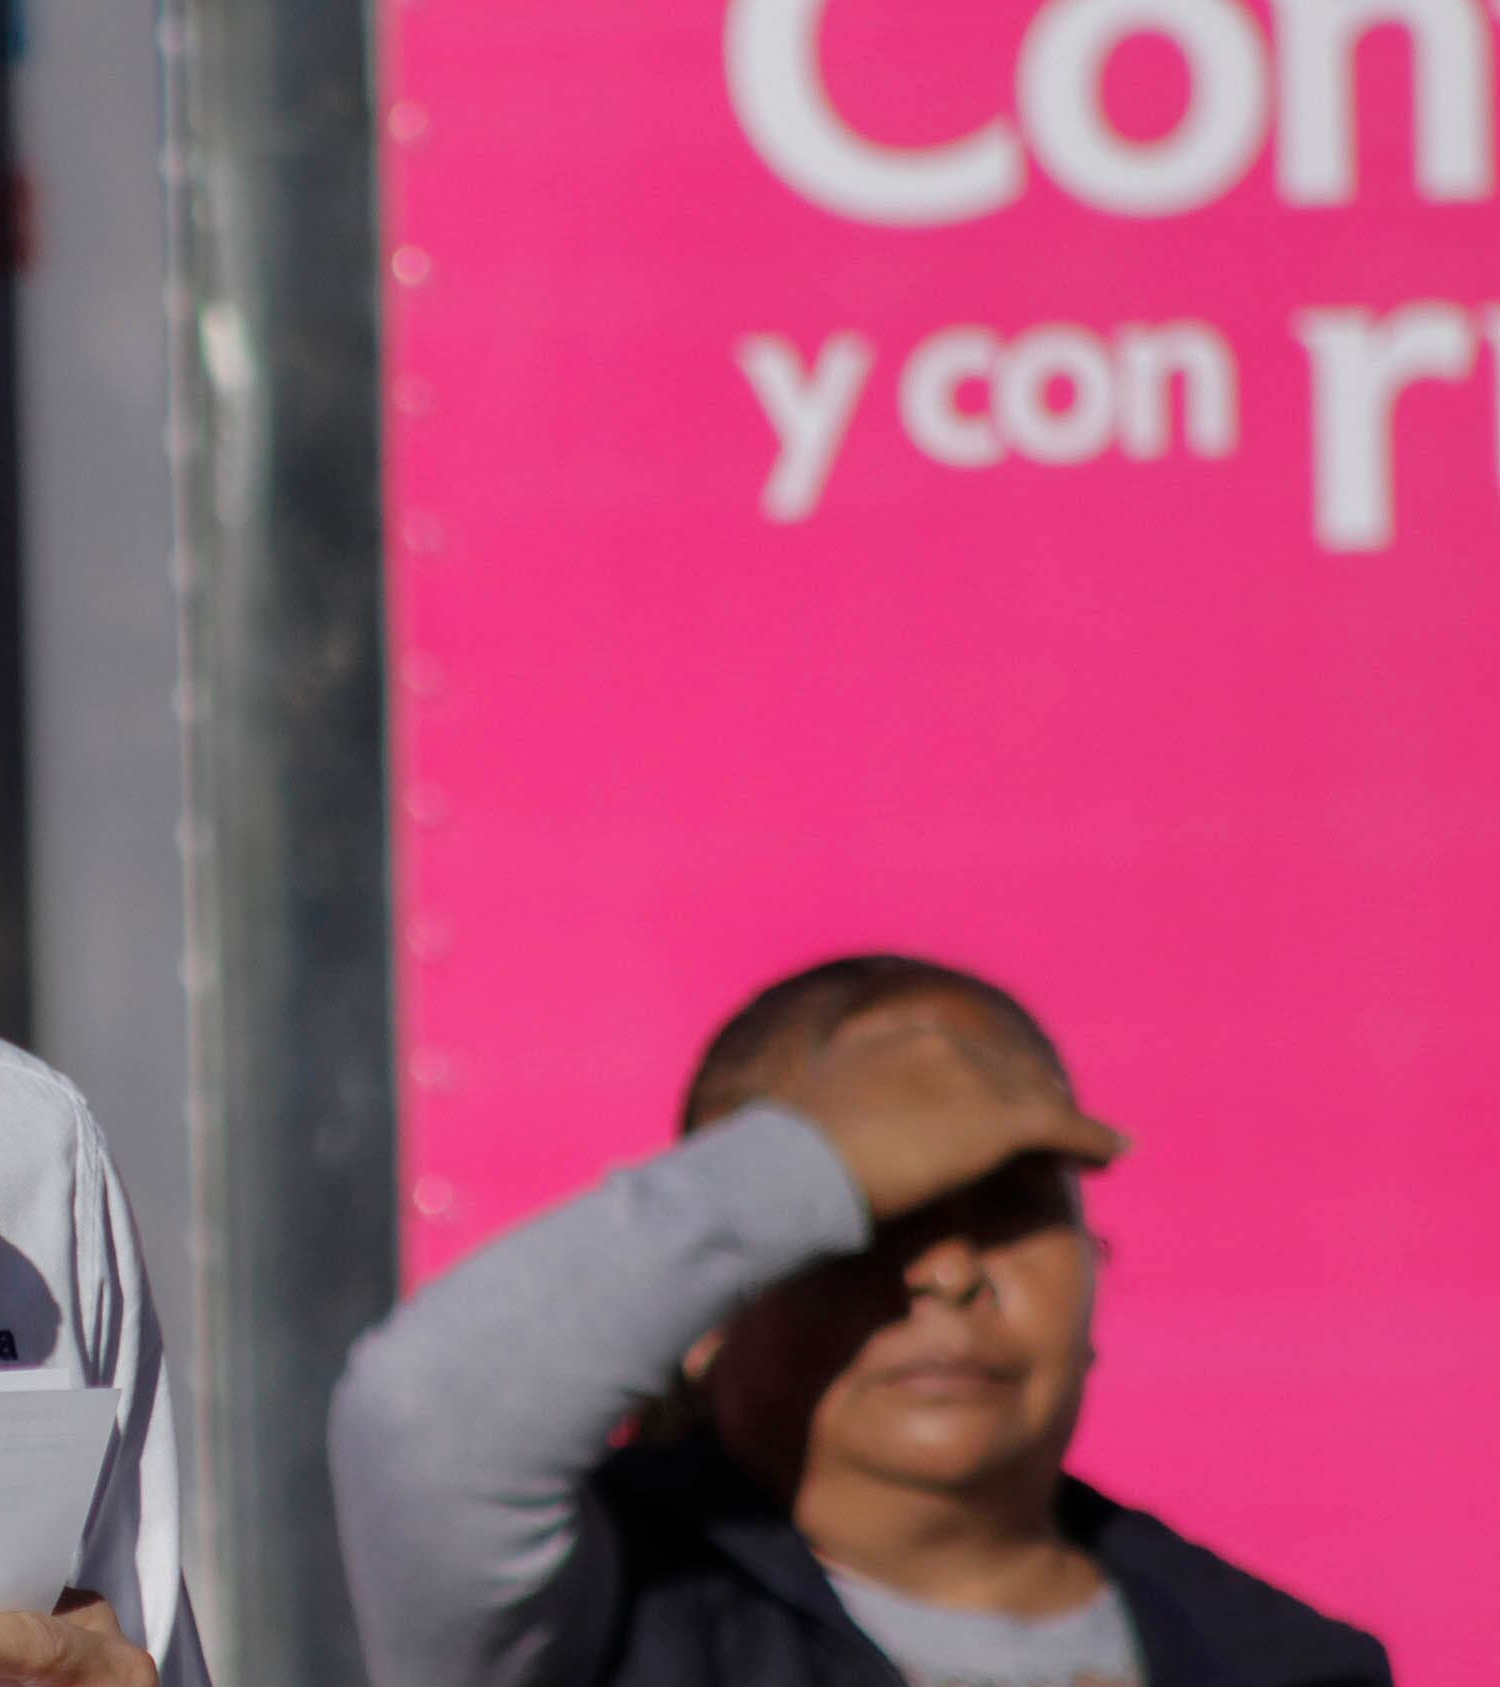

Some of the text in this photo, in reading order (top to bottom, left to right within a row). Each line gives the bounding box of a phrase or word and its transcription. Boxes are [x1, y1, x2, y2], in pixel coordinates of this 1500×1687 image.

[724, 0, 1500, 229] Con
[736, 300, 1500, 552] y con r
